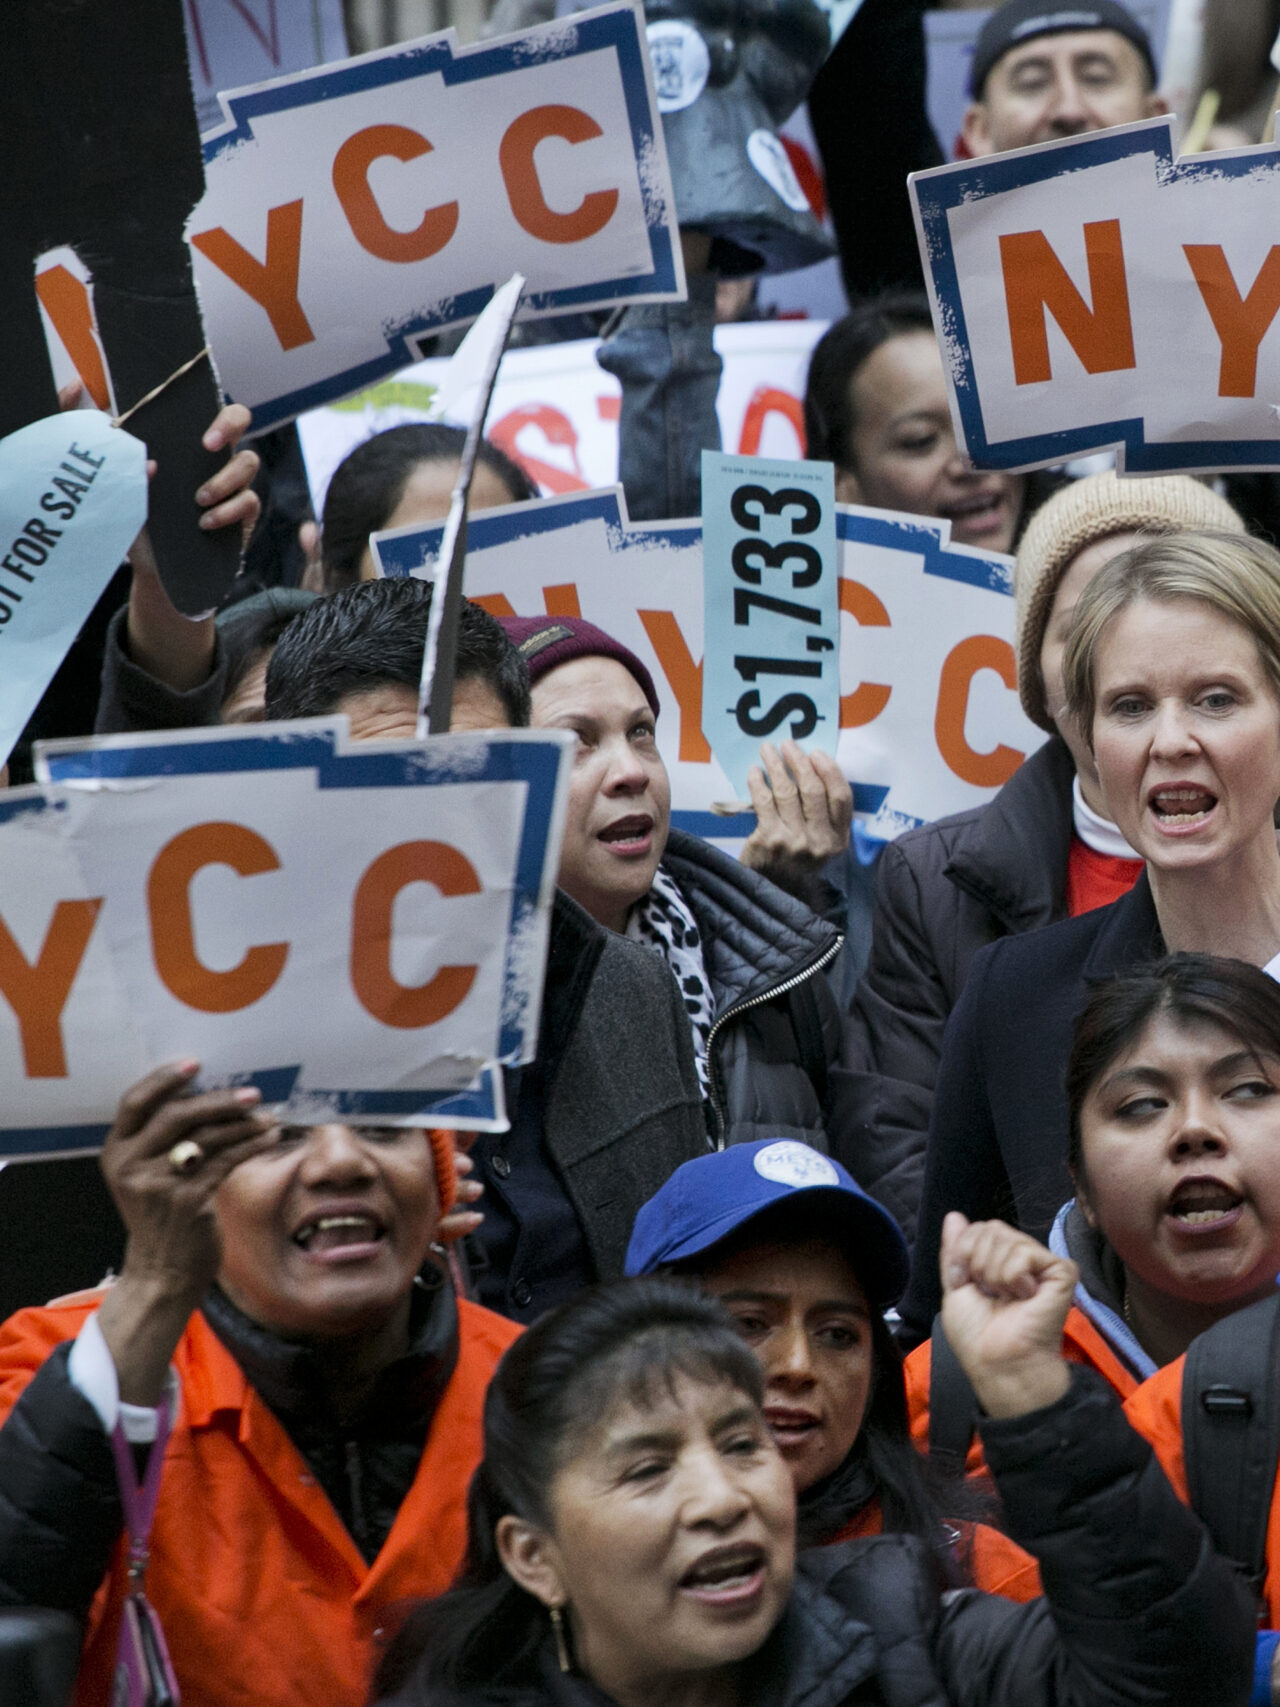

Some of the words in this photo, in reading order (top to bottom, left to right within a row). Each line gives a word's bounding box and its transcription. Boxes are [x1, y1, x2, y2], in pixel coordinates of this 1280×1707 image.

[1, 517, 63, 583] FOR
[40, 441, 106, 520] SALE
[726, 483, 826, 740] $1,733
[468, 577, 1027, 788] YCC
[0, 821, 483, 1080] YCC
